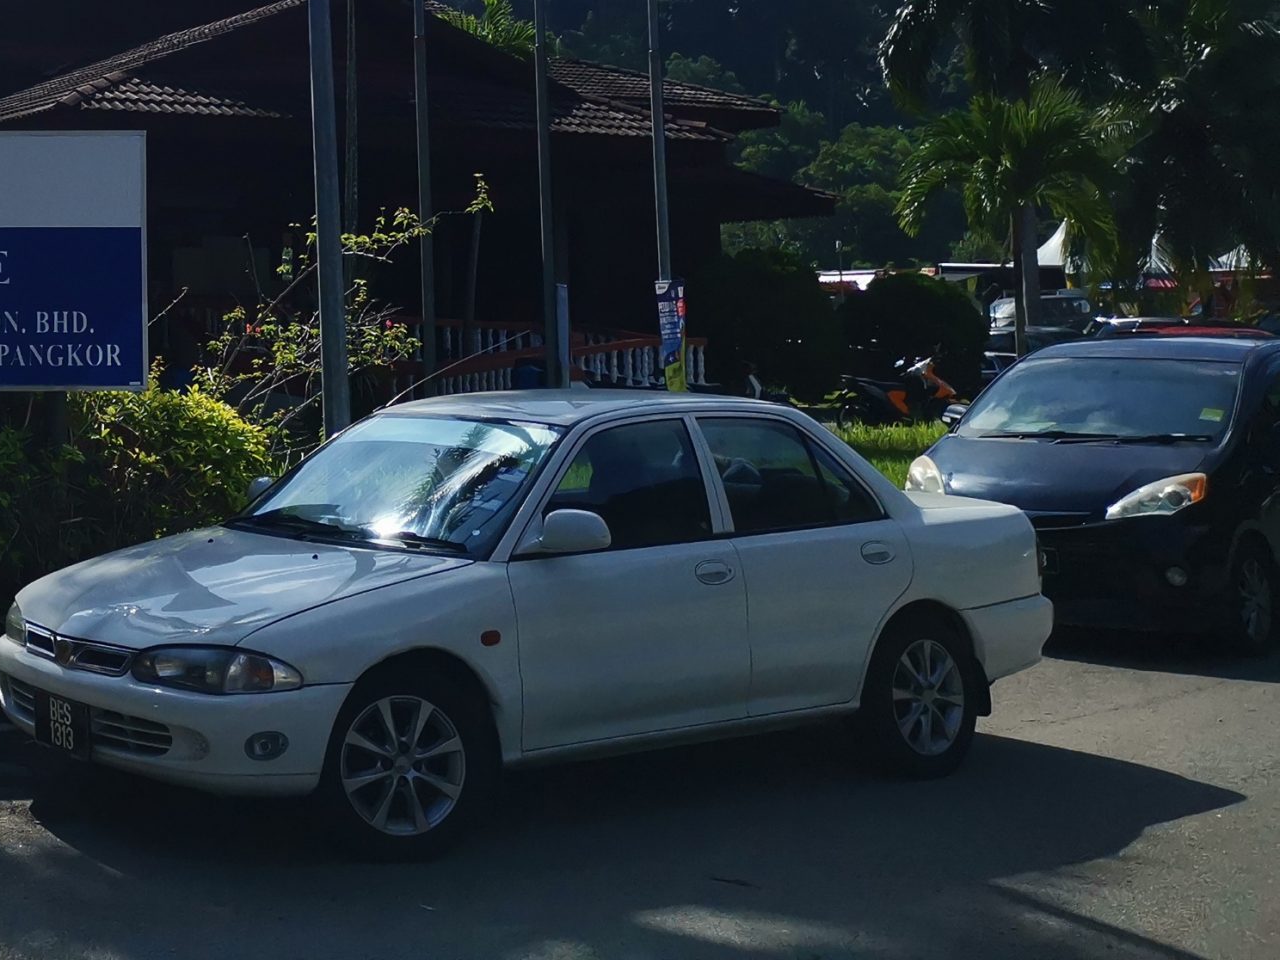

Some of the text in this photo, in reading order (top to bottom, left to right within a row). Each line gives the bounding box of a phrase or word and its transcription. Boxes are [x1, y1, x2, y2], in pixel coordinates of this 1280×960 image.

[36, 310, 95, 334] BHD.
[49, 695, 72, 726] BES
[50, 721, 74, 750] 1313
